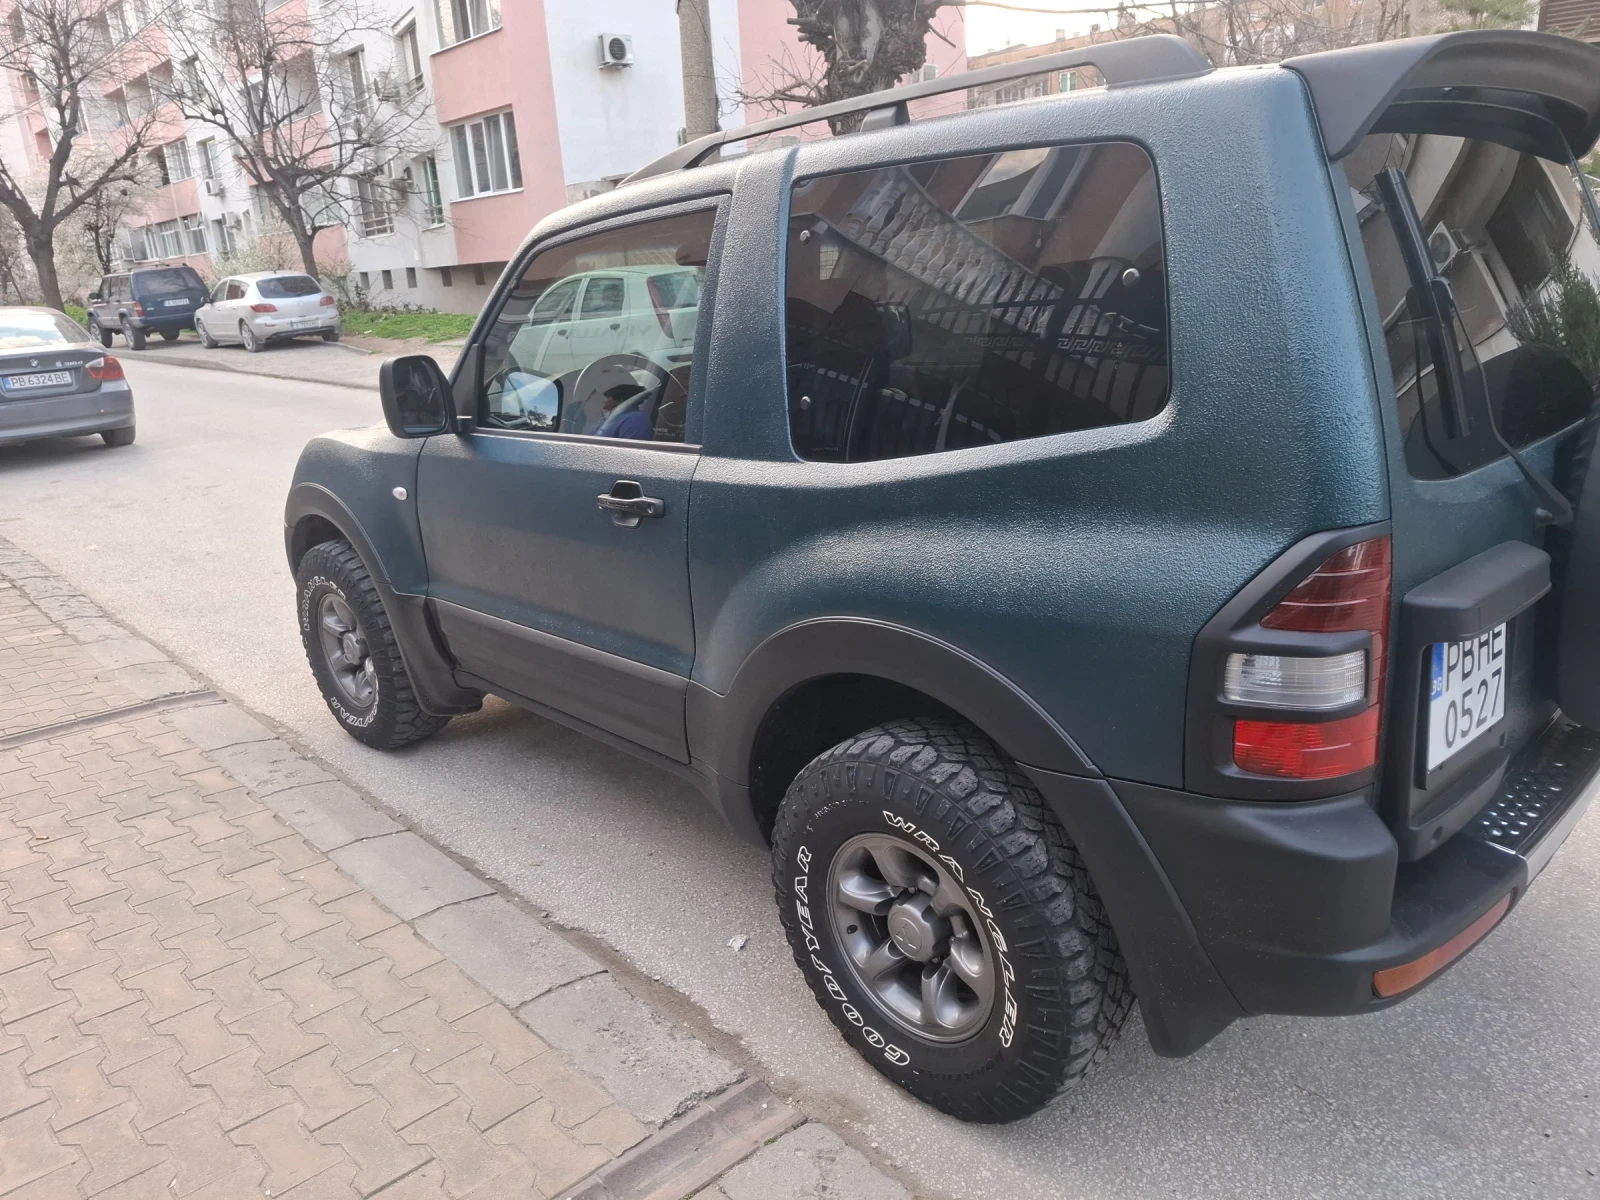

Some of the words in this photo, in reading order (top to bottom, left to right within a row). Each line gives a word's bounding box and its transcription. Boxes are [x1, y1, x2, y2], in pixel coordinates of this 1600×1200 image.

[11, 377, 26, 387] PB
[28, 375, 54, 386] 6324
[54, 372, 70, 383] BE
[1445, 666, 1502, 749] 0527
[794, 845, 910, 1066] GOODYEAR
[882, 810, 1019, 1048] WRANGLER
